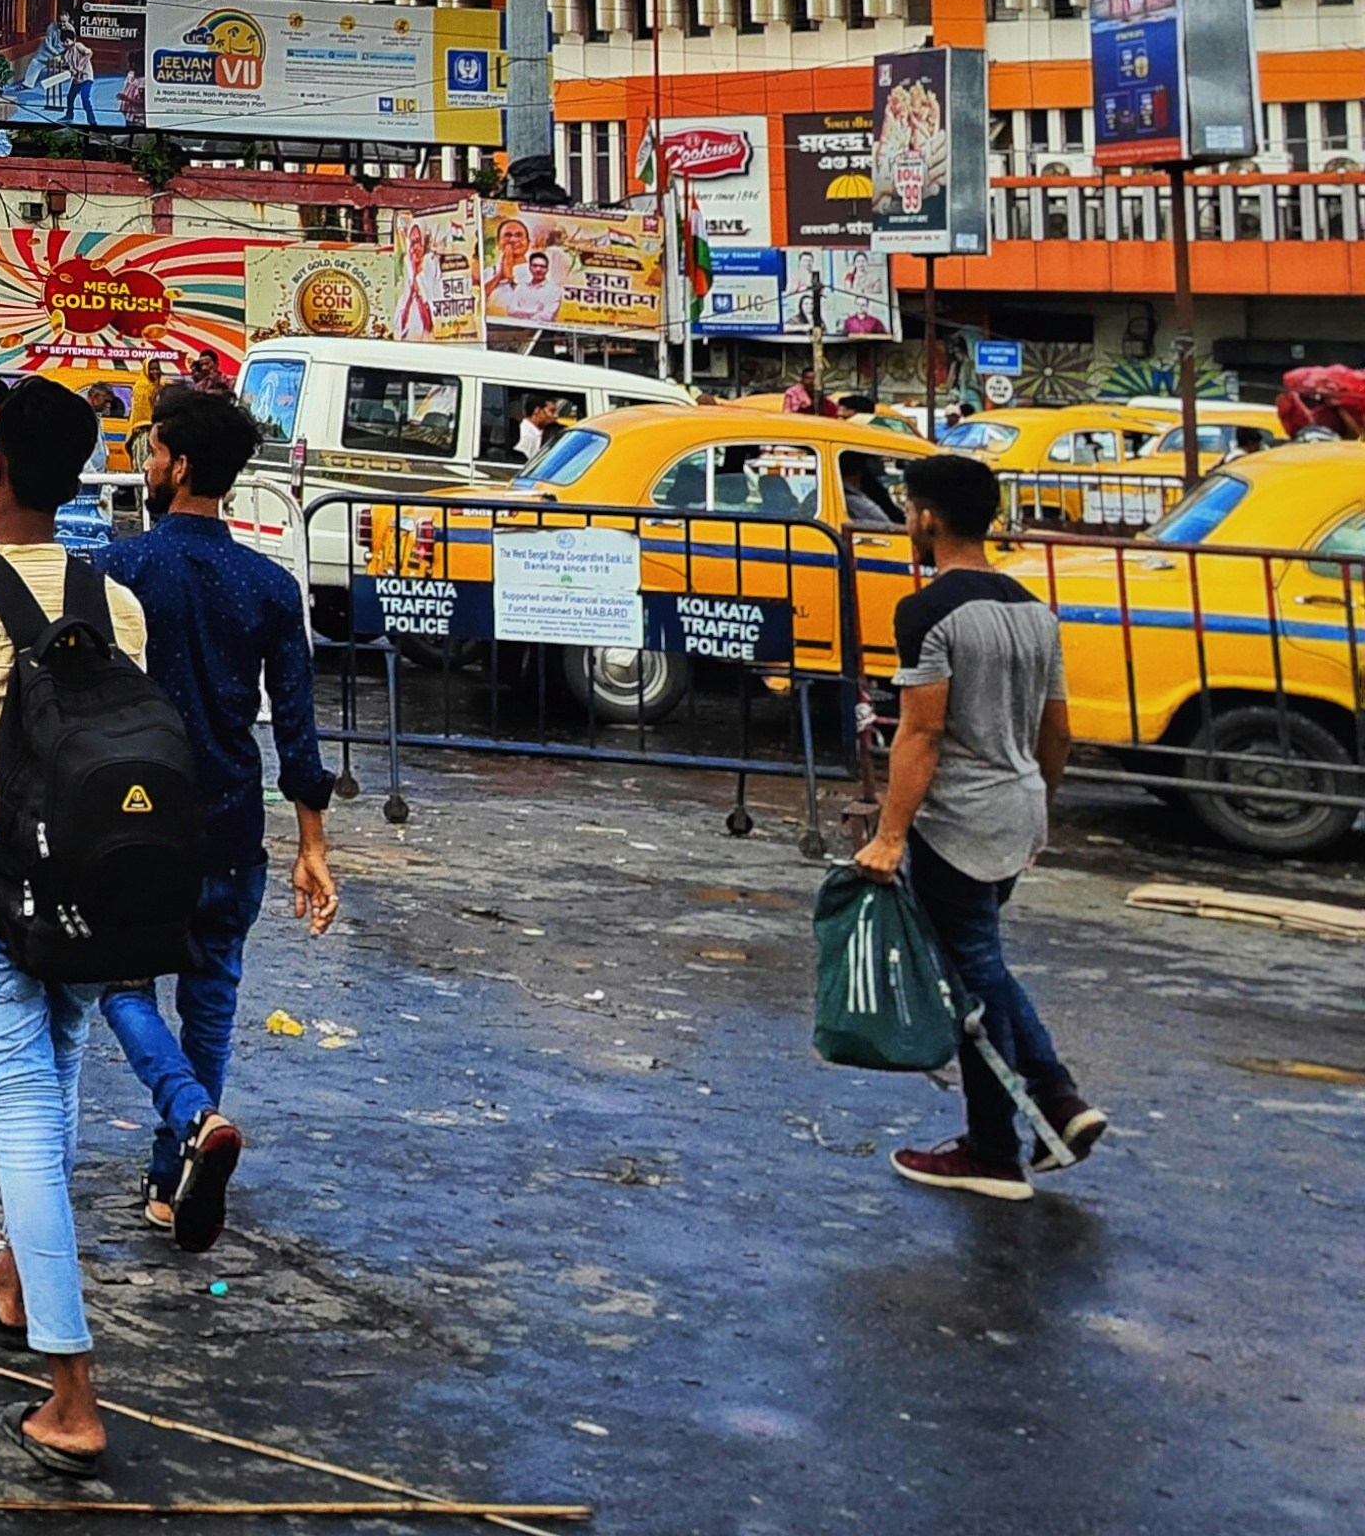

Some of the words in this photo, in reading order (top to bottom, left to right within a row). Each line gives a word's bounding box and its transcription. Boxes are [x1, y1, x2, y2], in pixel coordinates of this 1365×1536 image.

[80, 15, 120, 27] PLAYFUL
[80, 26, 138, 39] RETIREMENT
[156, 57, 212, 70] JEEVAN
[156, 70, 213, 83] AKSHAY
[221, 58, 257, 86] VII
[395, 99, 417, 113] LIC
[665, 138, 742, 170] Cookme
[291, 266, 308, 284] BUY
[334, 259, 352, 271] GET
[84, 281, 131, 295] MEGA
[311, 284, 353, 296] GOLD
[52, 293, 107, 310] GOLD
[110, 296, 164, 313] RUSH
[311, 296, 353, 309] COIN
[736, 294, 765, 313] LIC
[49, 346, 107, 358] SEPTEMBER,
[107, 348, 130, 359] 2023
[131, 349, 180, 361] ONWARDS
[500, 548, 511, 559] The
[511, 549, 526, 560] West
[528, 550, 549, 563] Bengal
[549, 550, 566, 561] State
[605, 553, 621, 564] Bank
[524, 561, 561, 573] Banking
[563, 563, 587, 573] since
[588, 563, 610, 574] 1918
[376, 578, 458, 599] KOLKATA
[502, 590, 540, 603] Supported
[542, 592, 563, 603] under
[564, 592, 599, 605] Financial
[379, 597, 454, 617] TRAFFIC
[508, 604, 528, 614] Fund
[530, 604, 572, 616] maintained
[573, 606, 583, 618] by
[584, 606, 628, 619] NABARD
[677, 596, 764, 624] KOLKATA
[384, 615, 449, 635] POLICE
[680, 616, 760, 642] TRAFFIC
[685, 636, 755, 661] POLICE
